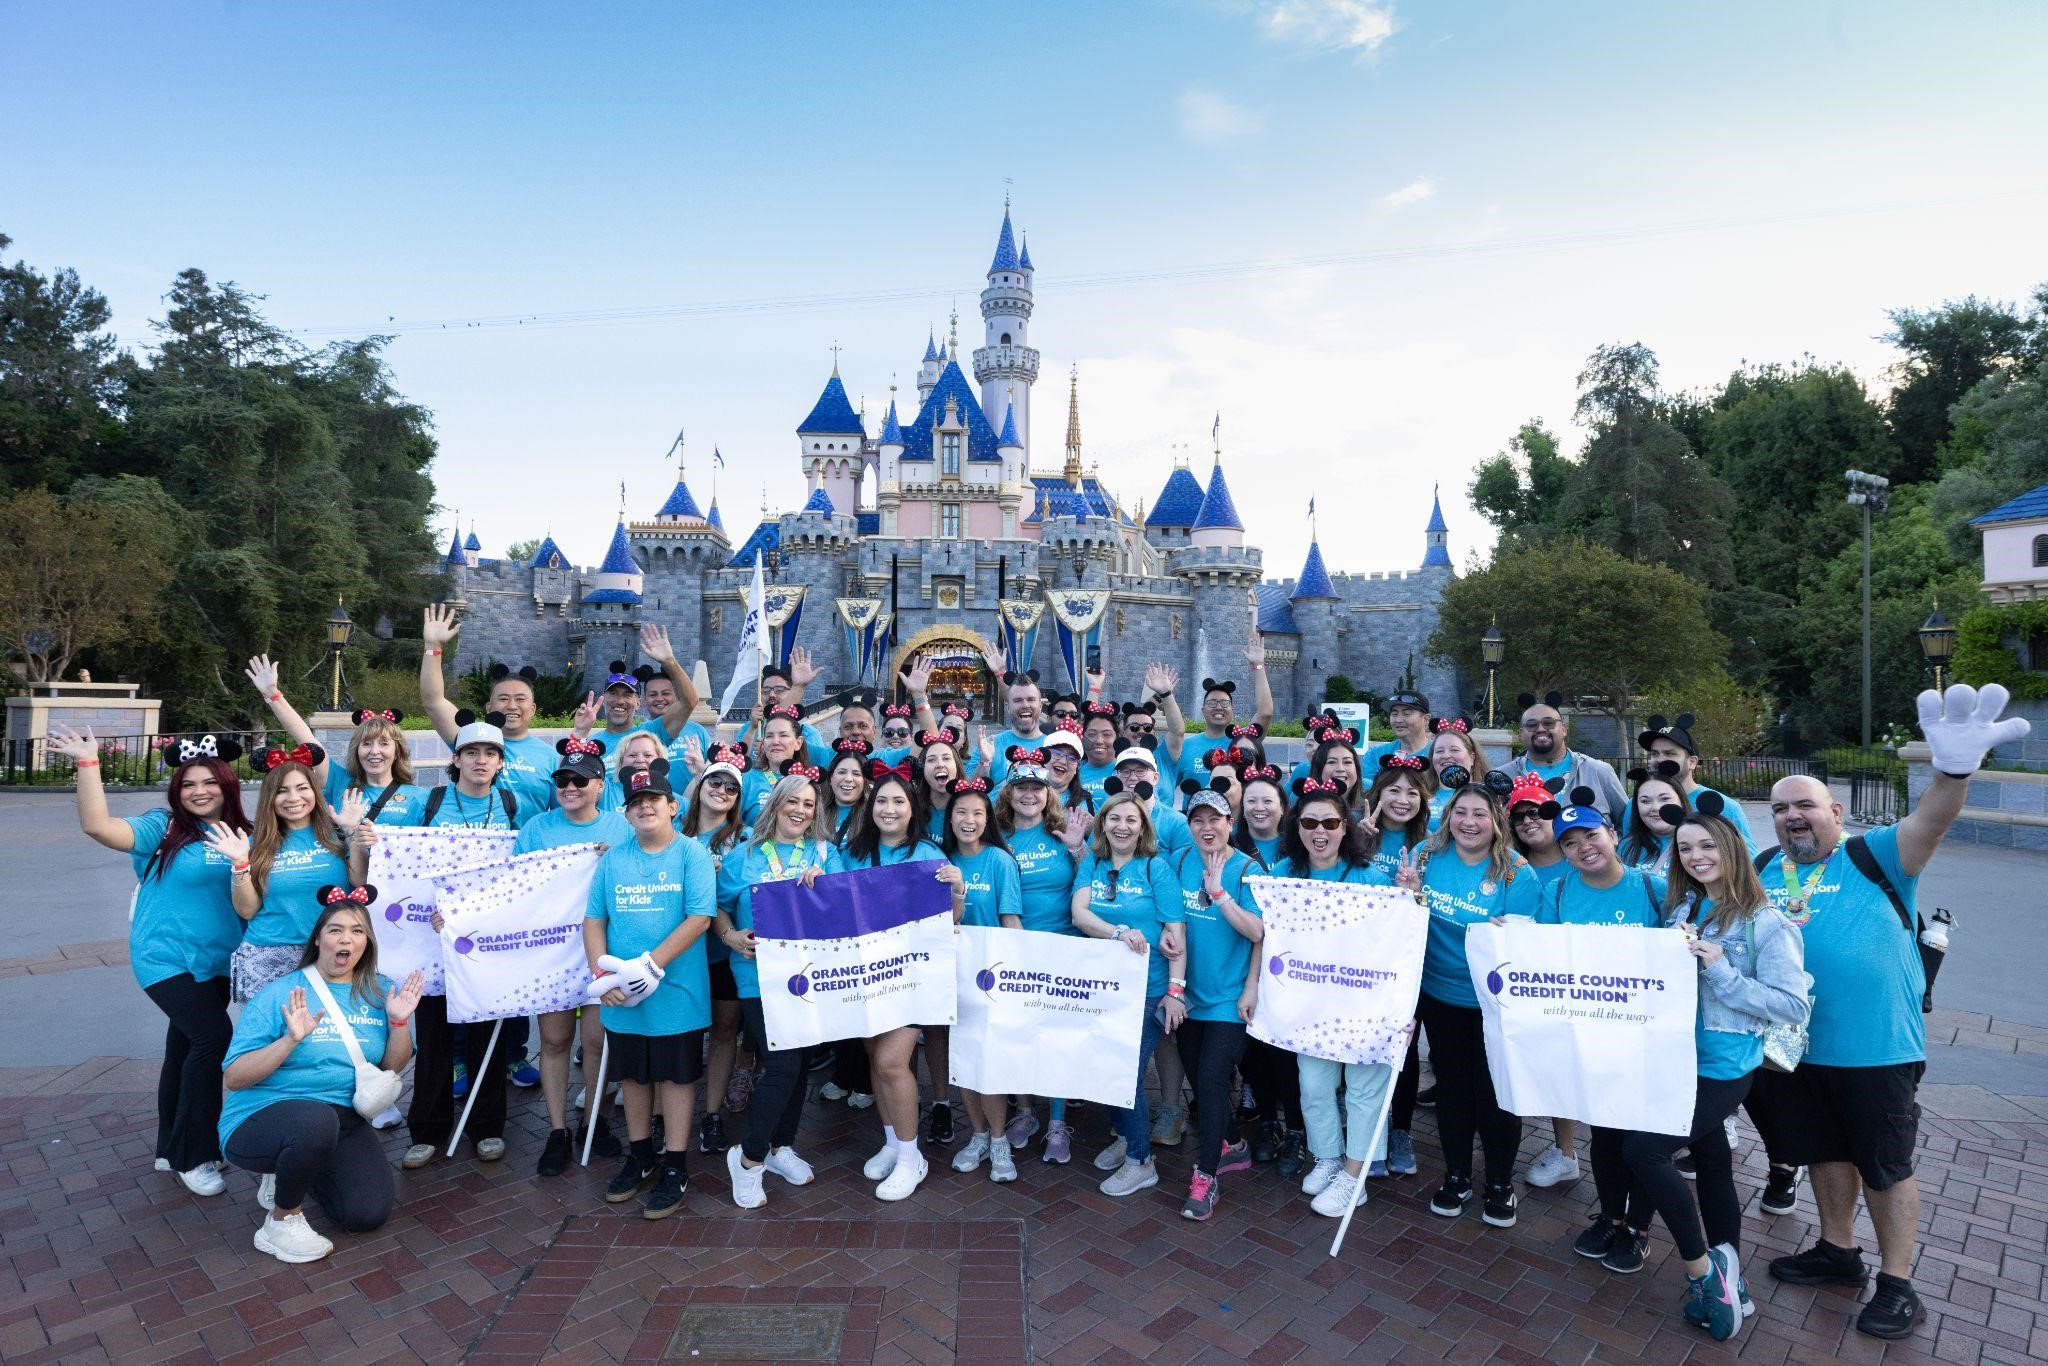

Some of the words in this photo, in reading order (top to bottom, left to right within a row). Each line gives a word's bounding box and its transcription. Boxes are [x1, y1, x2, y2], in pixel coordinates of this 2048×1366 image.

[287, 856, 313, 866] Kids
[615, 884, 647, 895] Credit
[647, 882, 682, 893] Unions
[616, 894, 629, 905] for
[629, 894, 652, 905] Kids
[1421, 884, 1453, 906] Credit
[1453, 896, 1489, 916] Unions
[407, 903, 433, 913] ORA
[1431, 900, 1455, 916] Kids
[406, 913, 431, 923] CRE
[477, 931, 528, 944] ORANGE
[478, 942, 522, 953] CREDIT
[811, 964, 866, 980] ORANGE
[869, 952, 930, 972] COUNTY'S
[1288, 959, 1336, 973] ORANGE
[999, 970, 1052, 984] ORANGE
[1054, 976, 1120, 991] COUNTY'S
[1287, 969, 1328, 984] CREDIT
[1508, 971, 1576, 985] ORANGE
[1579, 974, 1665, 991] COUNTY'S
[813, 978, 859, 992] CREDIT
[999, 982, 1043, 994] CREDIT
[1509, 985, 1566, 999] CREDIT
[842, 992, 862, 1004] with
[861, 991, 876, 1004] you
[888, 983, 901, 994] the
[1023, 998, 1042, 1008] with
[1041, 1001, 1057, 1011] you
[1058, 1002, 1070, 1012] all
[1070, 1004, 1084, 1013] the
[1085, 1007, 1103, 1016] way
[348, 1014, 384, 1027] Unions
[1543, 1005, 1568, 1016] with
[1567, 1008, 1587, 1019] you
[1589, 1007, 1604, 1019] all
[1605, 1008, 1623, 1020] the
[1626, 1013, 1649, 1025] way
